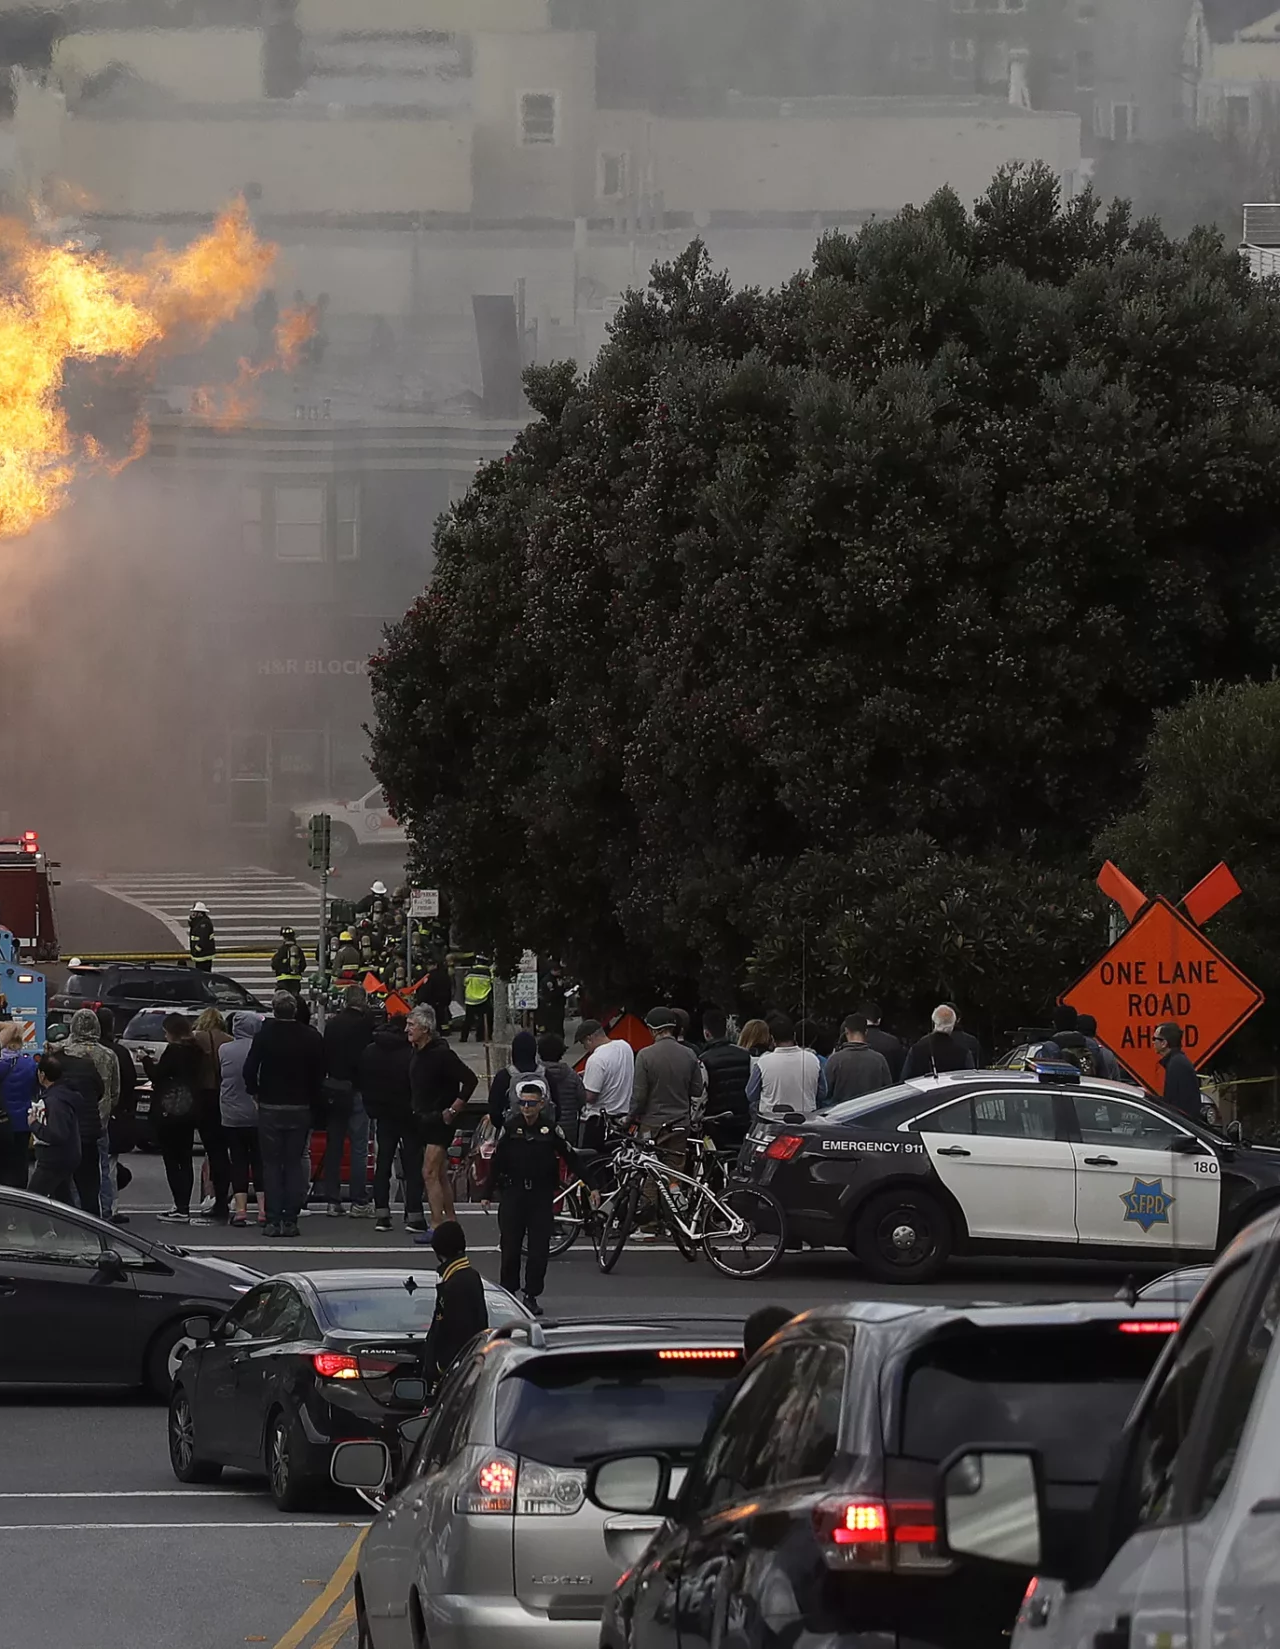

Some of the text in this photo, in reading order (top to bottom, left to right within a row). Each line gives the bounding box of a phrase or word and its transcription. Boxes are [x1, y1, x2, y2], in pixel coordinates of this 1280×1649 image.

[305, 660, 368, 675] BLOCK
[1101, 961, 1218, 985] ONE LANE
[1128, 993, 1191, 1016] ROAD
[1121, 1025, 1199, 1049] AHD
[822, 1140, 900, 1152] EMERGENCY
[904, 1143, 924, 1154] 911
[1193, 1161, 1218, 1174] 180
